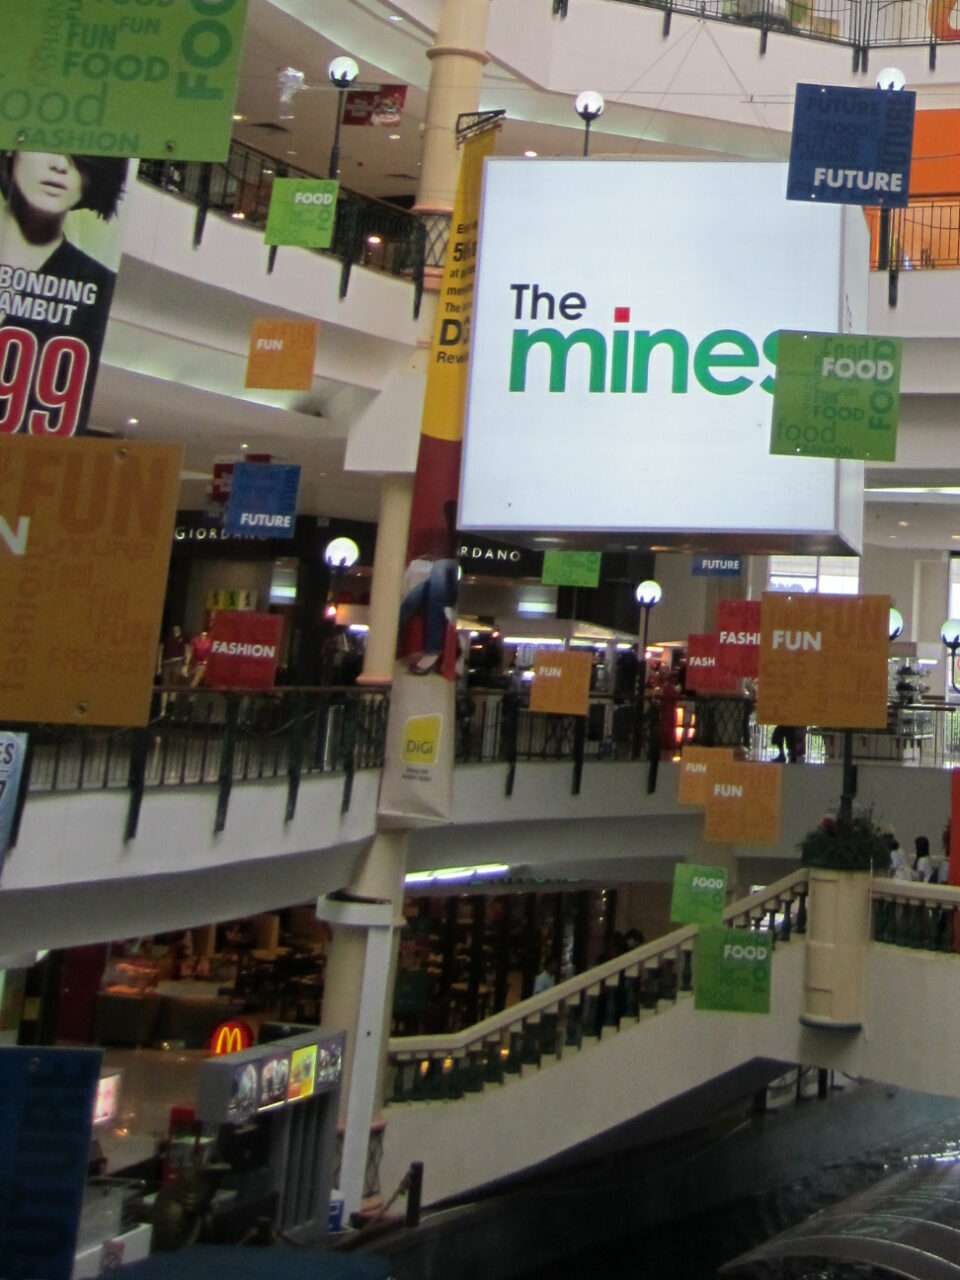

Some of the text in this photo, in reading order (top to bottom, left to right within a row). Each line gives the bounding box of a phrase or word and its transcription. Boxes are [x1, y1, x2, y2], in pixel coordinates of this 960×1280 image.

[63, 52, 170, 82] FOOD
[0, 82, 107, 126] ood
[814, 167, 903, 192] FUTURE
[294, 192, 332, 205] FOOD
[0, 291, 77, 326] AMBUT
[510, 283, 587, 321] The
[257, 338, 283, 351] FUN
[821, 357, 894, 381] FOOD
[240, 513, 291, 527] FUTURE
[459, 546, 520, 561] RDANO
[702, 559, 740, 570] FUTURE
[720, 631, 760, 645] FASHI
[772, 630, 822, 651] FUN
[212, 641, 276, 658] FASHION
[689, 656, 715, 667] FASH
[539, 665, 562, 677] FUN
[686, 762, 706, 773] FUN
[713, 784, 743, 798] FUN
[692, 876, 724, 889] FOOD
[723, 944, 768, 960] FOOD
